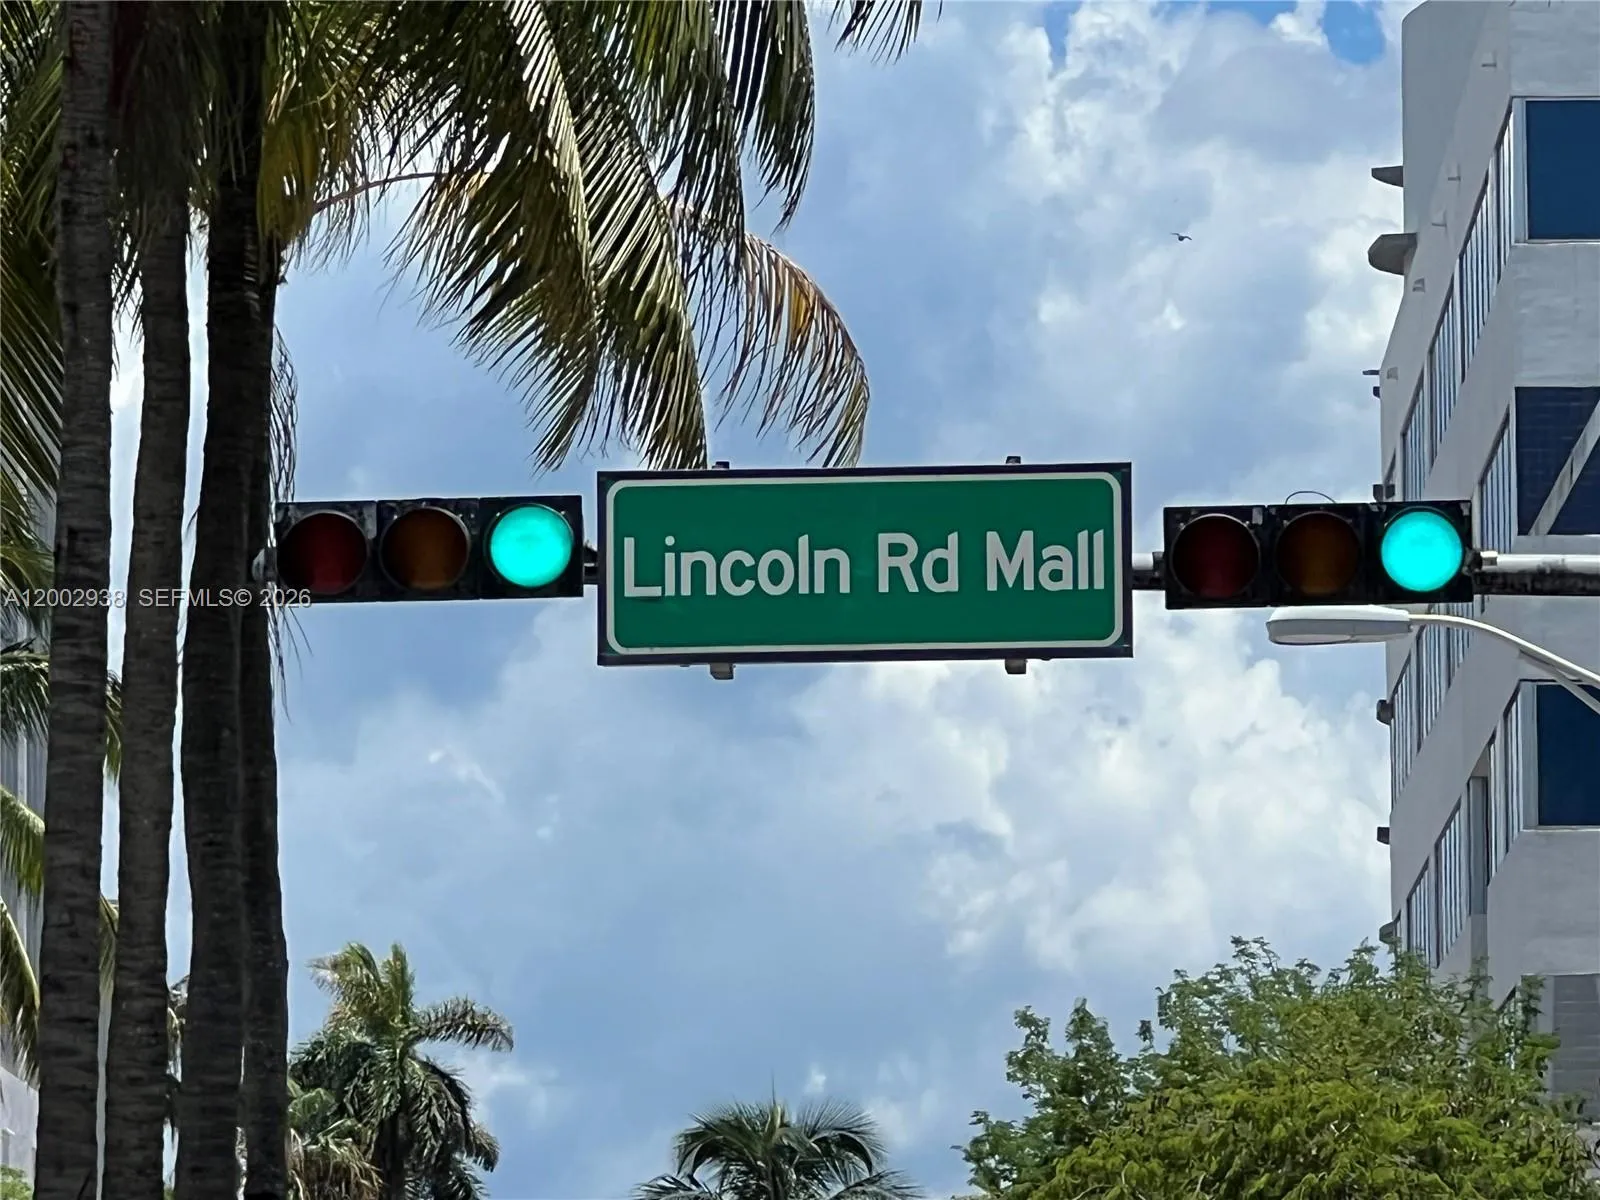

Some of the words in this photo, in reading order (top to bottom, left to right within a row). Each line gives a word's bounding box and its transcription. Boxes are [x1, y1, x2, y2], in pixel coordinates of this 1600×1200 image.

[623, 533, 851, 598] Lincoln
[878, 531, 959, 594] Rd
[986, 528, 1105, 592] Mall
